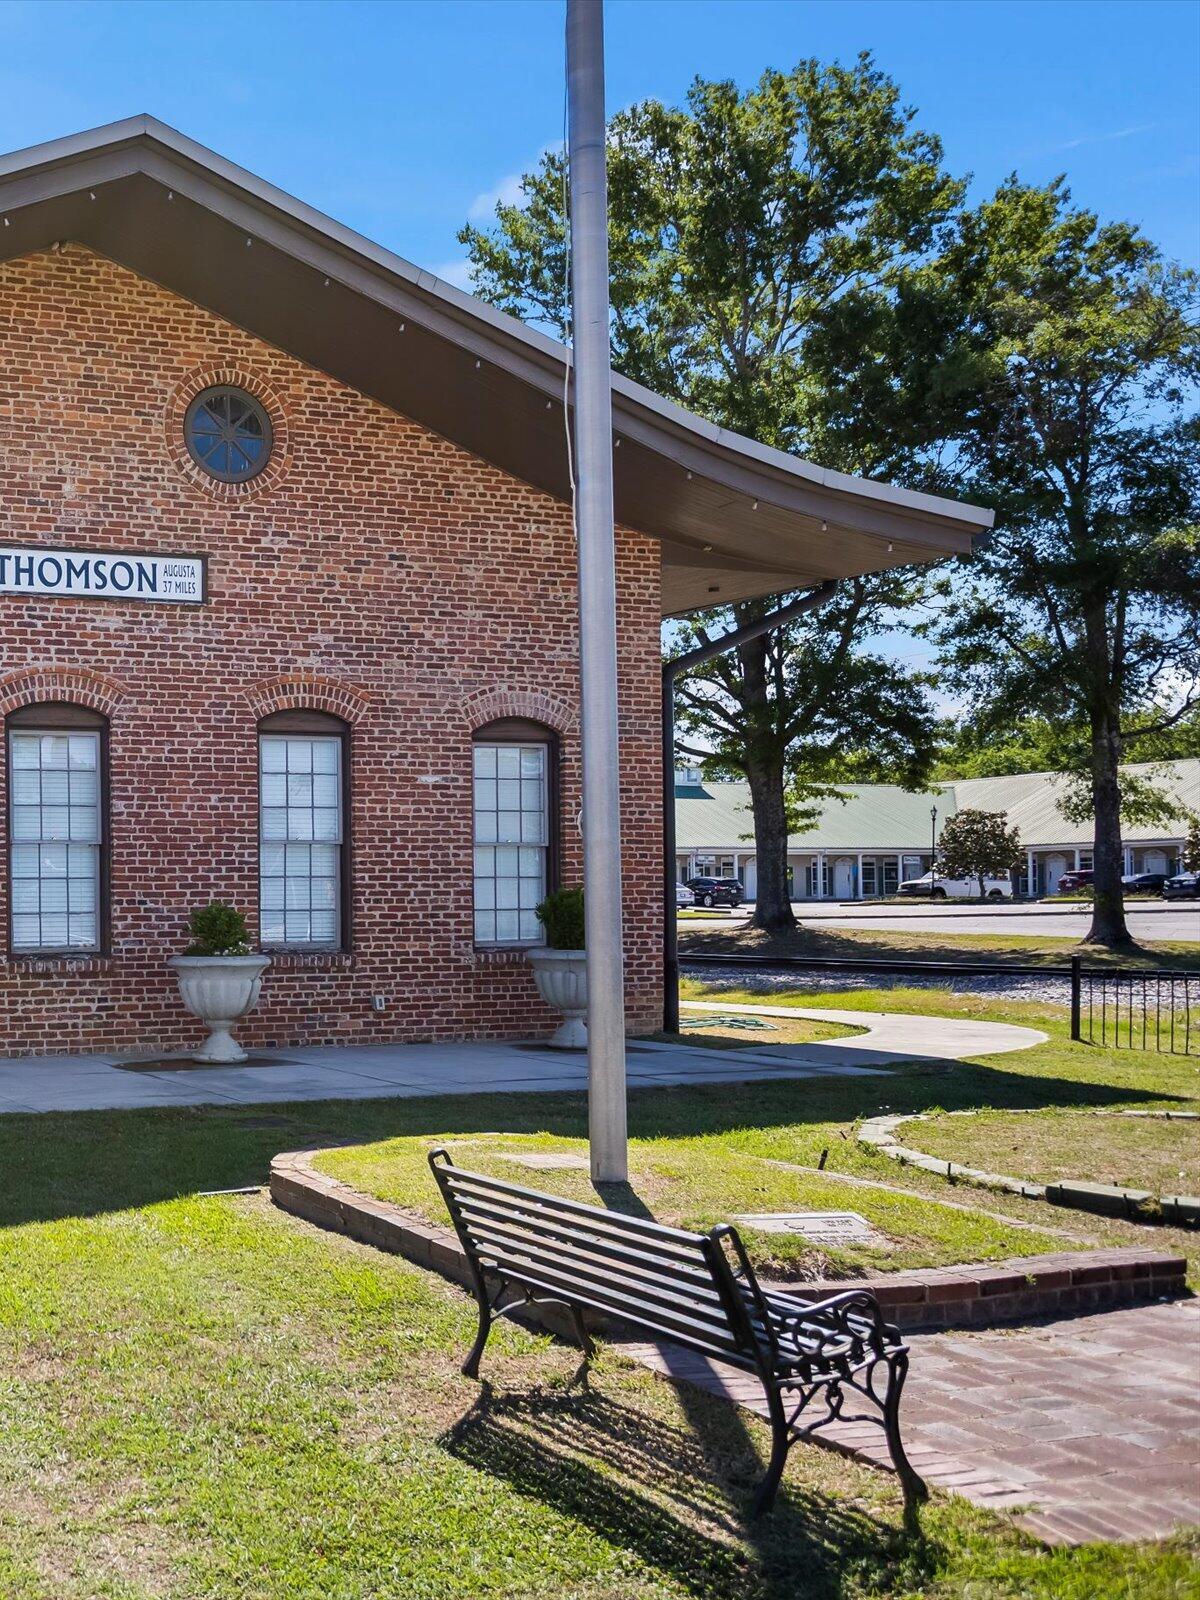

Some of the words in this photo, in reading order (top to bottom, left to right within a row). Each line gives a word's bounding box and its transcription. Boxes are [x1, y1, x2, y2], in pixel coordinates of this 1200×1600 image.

[163, 564, 196, 578] AUGUSTA
[163, 580, 172, 593] 37
[175, 581, 196, 594] MILES
